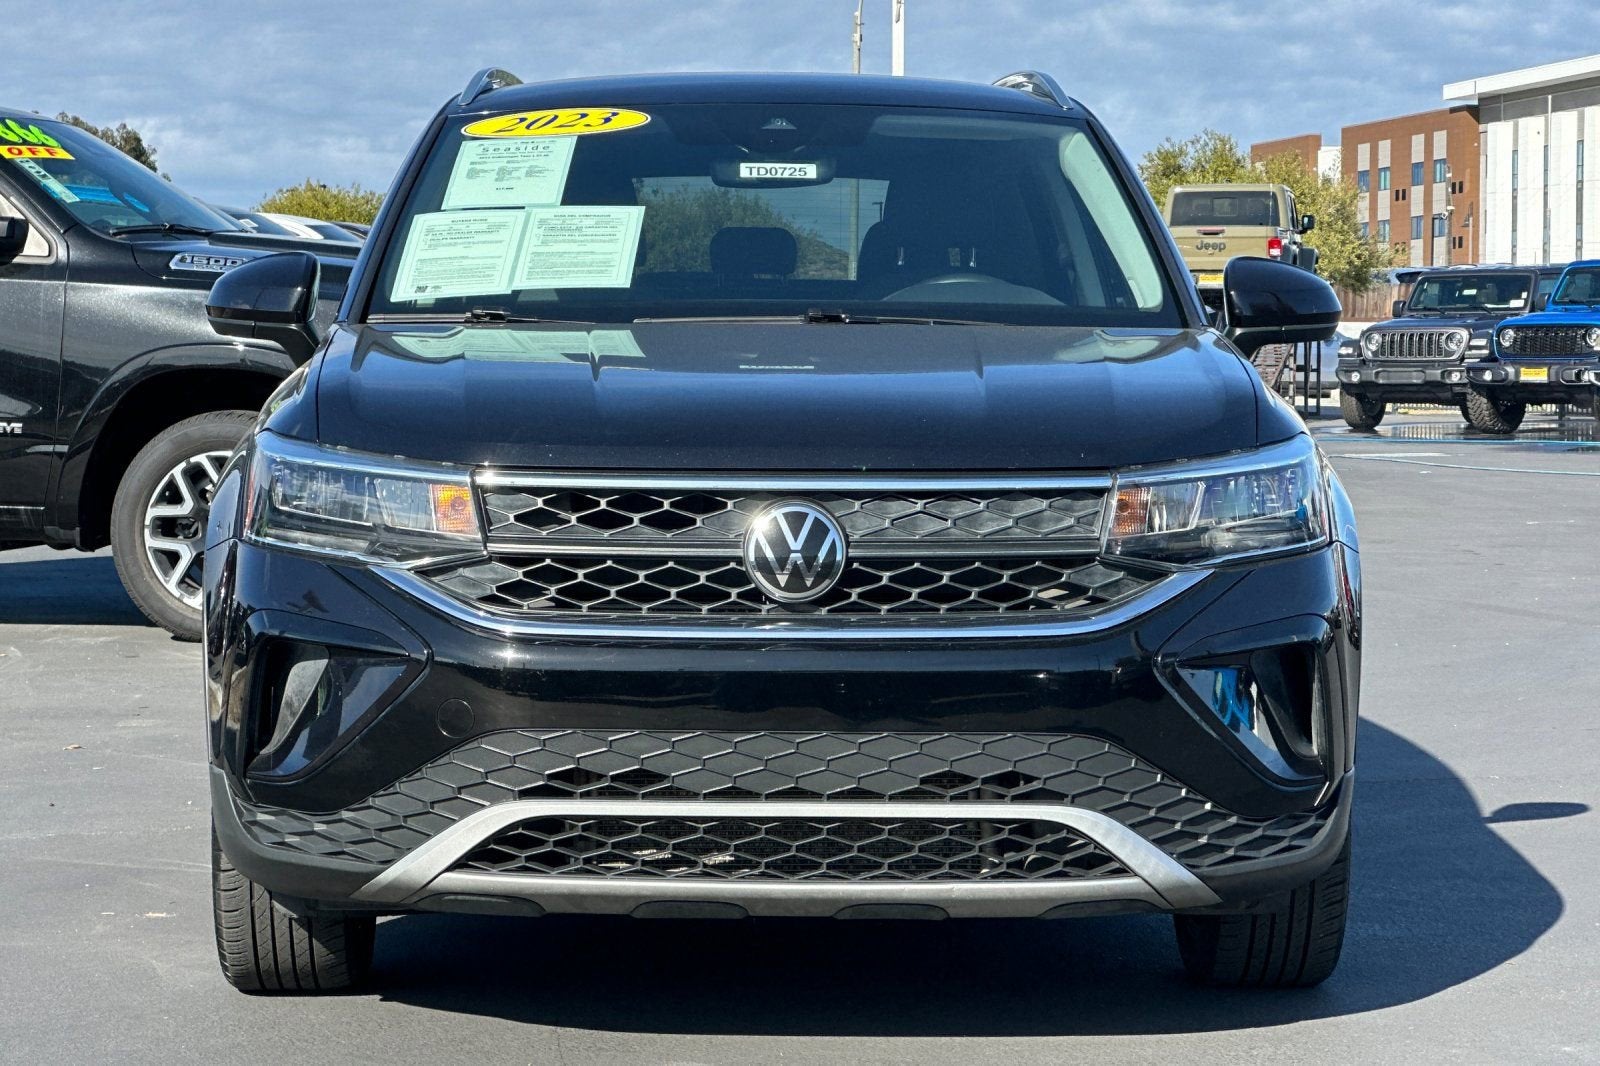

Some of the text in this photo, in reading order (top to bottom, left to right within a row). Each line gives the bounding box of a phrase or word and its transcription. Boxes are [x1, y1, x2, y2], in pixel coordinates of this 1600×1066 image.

[491, 111, 620, 134] 2023
[6, 146, 58, 156] OFF
[481, 145, 550, 153] Seaside
[745, 166, 807, 177] TD0725
[1196, 240, 1226, 252] Jeep
